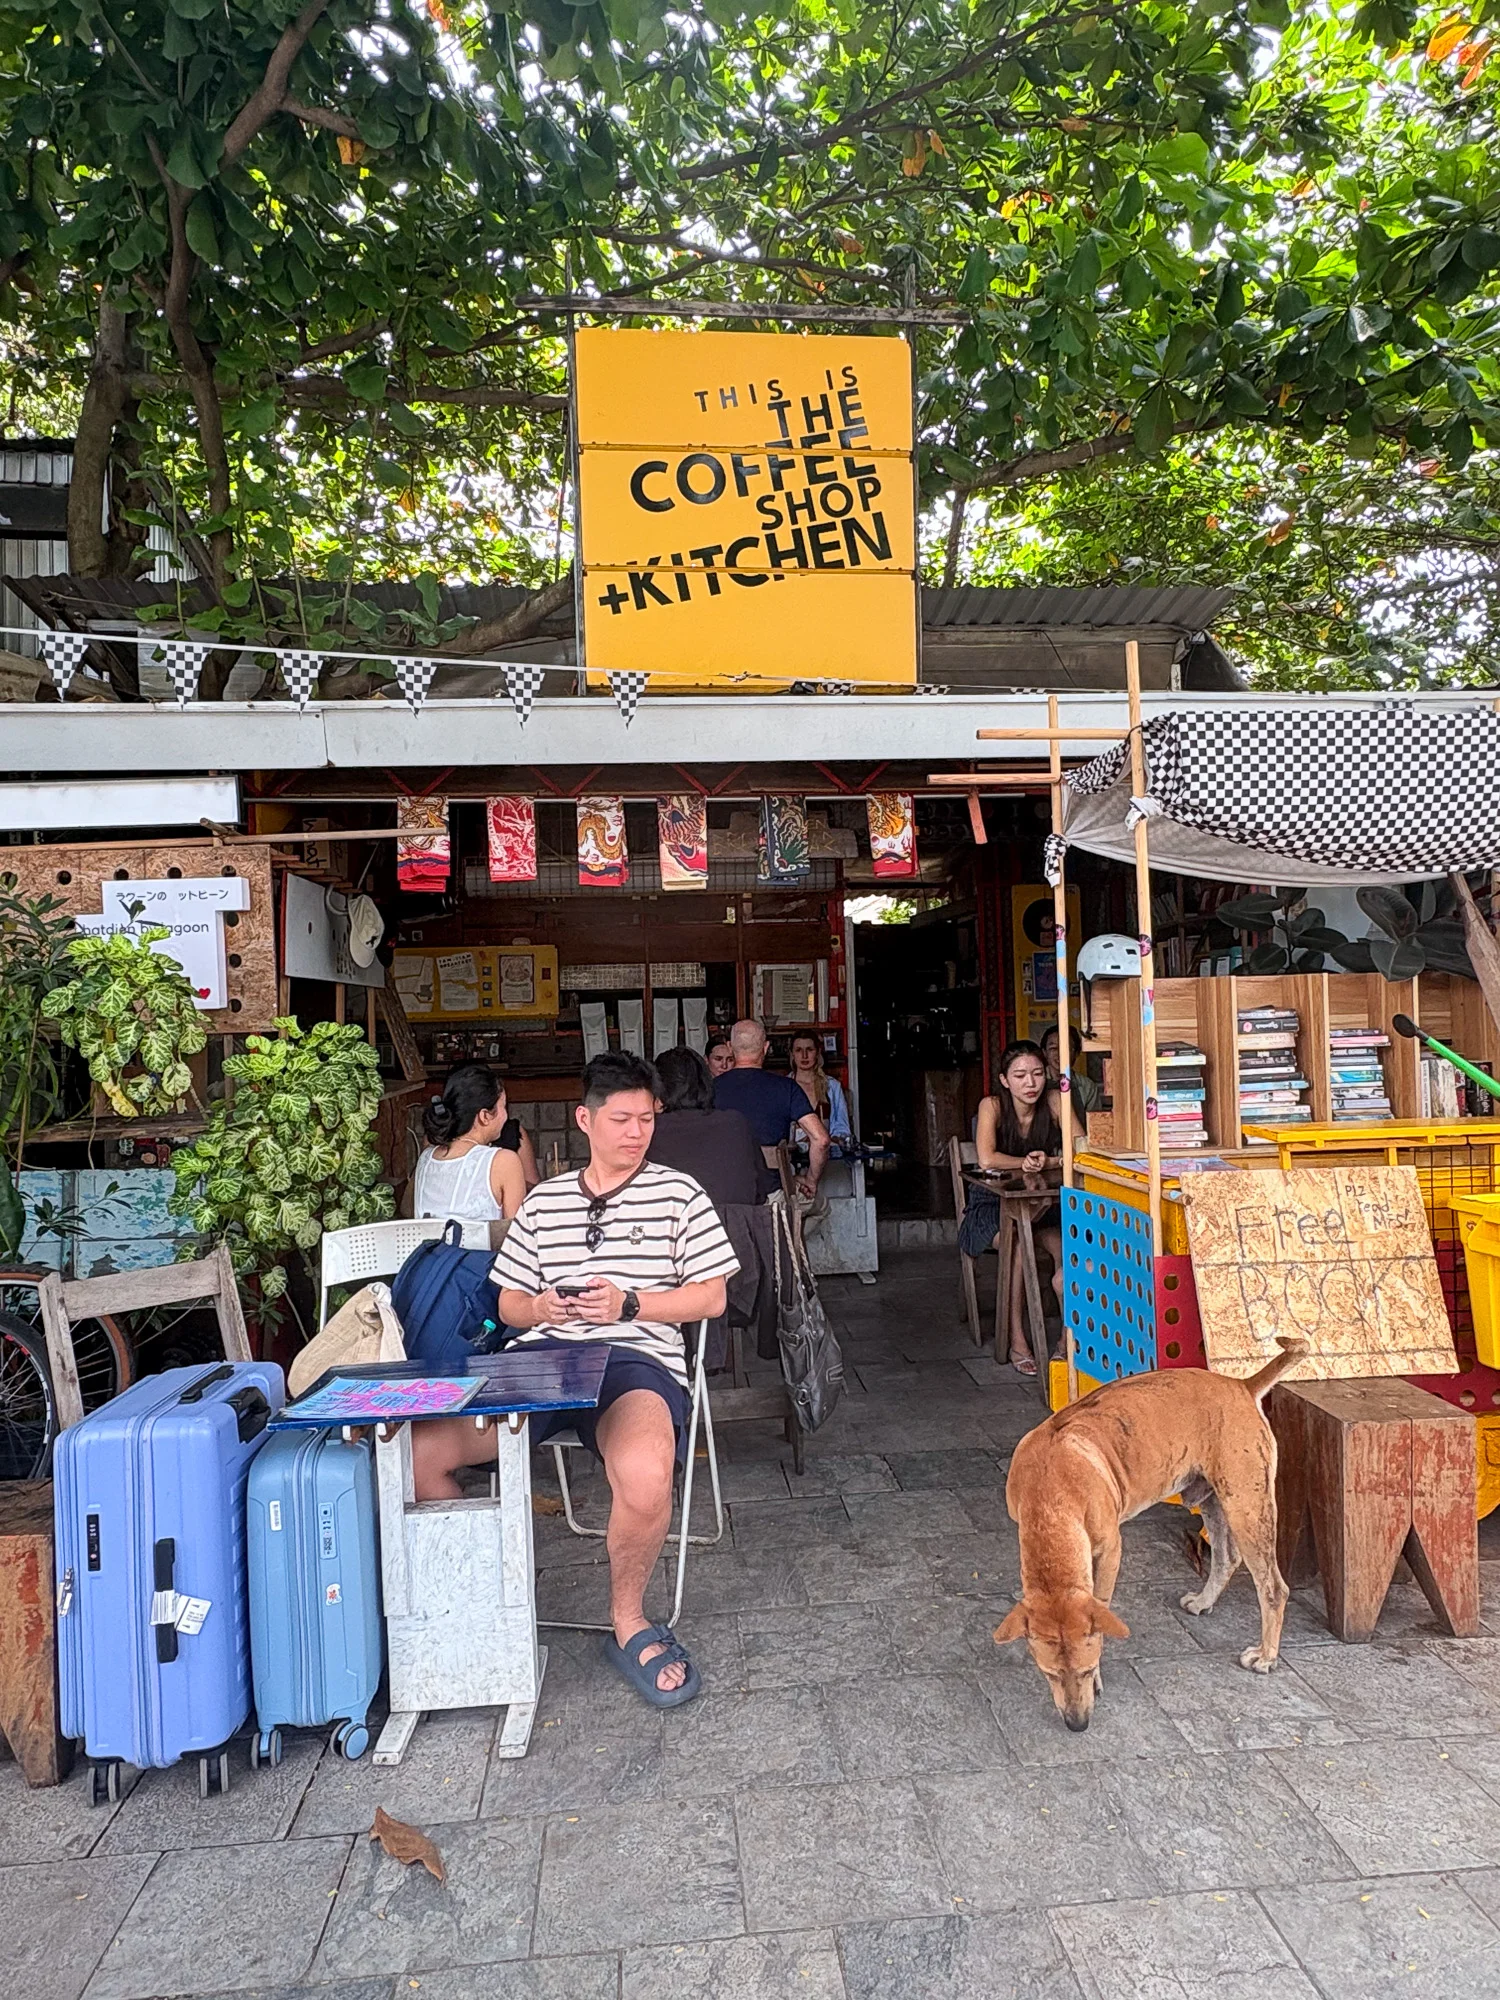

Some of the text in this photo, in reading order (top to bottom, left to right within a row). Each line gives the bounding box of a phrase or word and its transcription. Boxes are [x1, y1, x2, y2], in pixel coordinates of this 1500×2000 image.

[694, 365, 859, 413] THIS IS
[767, 387, 866, 439] THE
[630, 426, 878, 513] COFFEE
[756, 476, 882, 531] SHOP
[163, 922, 209, 937] agoon
[1356, 1192, 1389, 1214] read
[1235, 1204, 1355, 1258] Free
[1236, 1260, 1432, 1343] BOOKS
